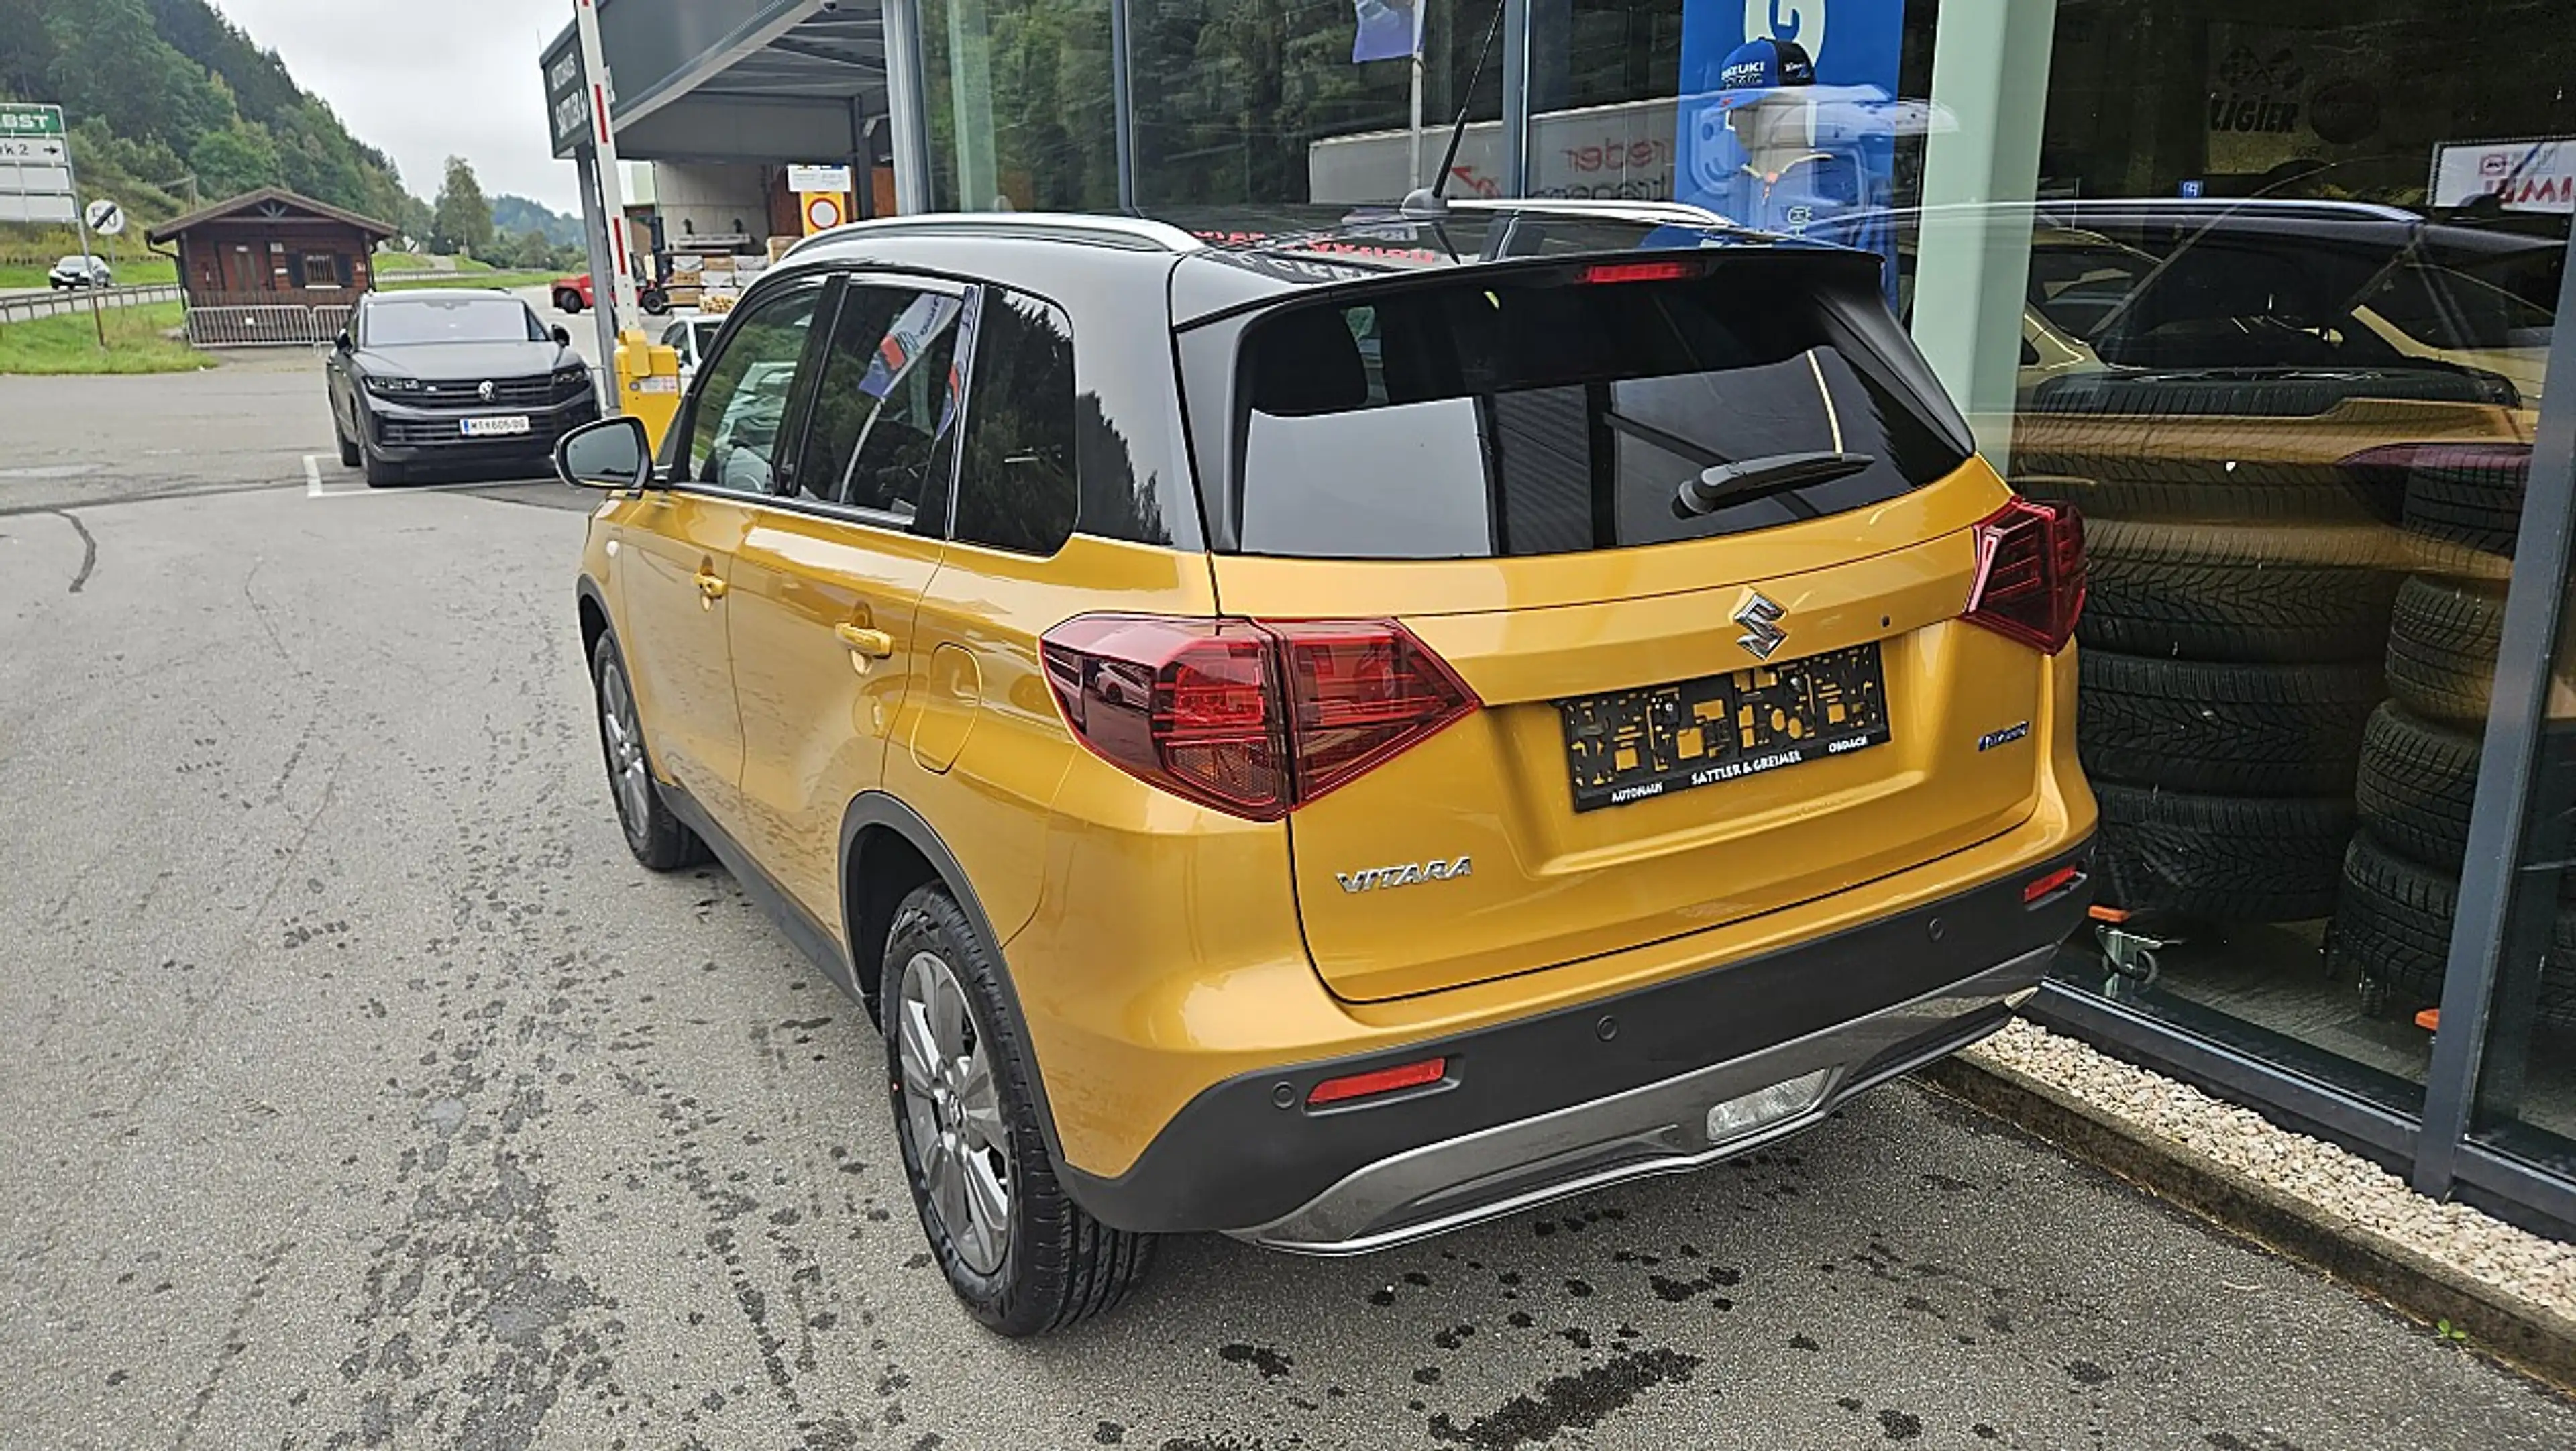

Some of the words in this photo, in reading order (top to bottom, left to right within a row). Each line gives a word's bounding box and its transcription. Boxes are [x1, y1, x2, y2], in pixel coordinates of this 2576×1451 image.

[0, 113, 49, 129] BST
[1690, 763, 1742, 785] SATTLER
[1743, 761, 1753, 775] &
[1335, 855, 1473, 894] VITARA
